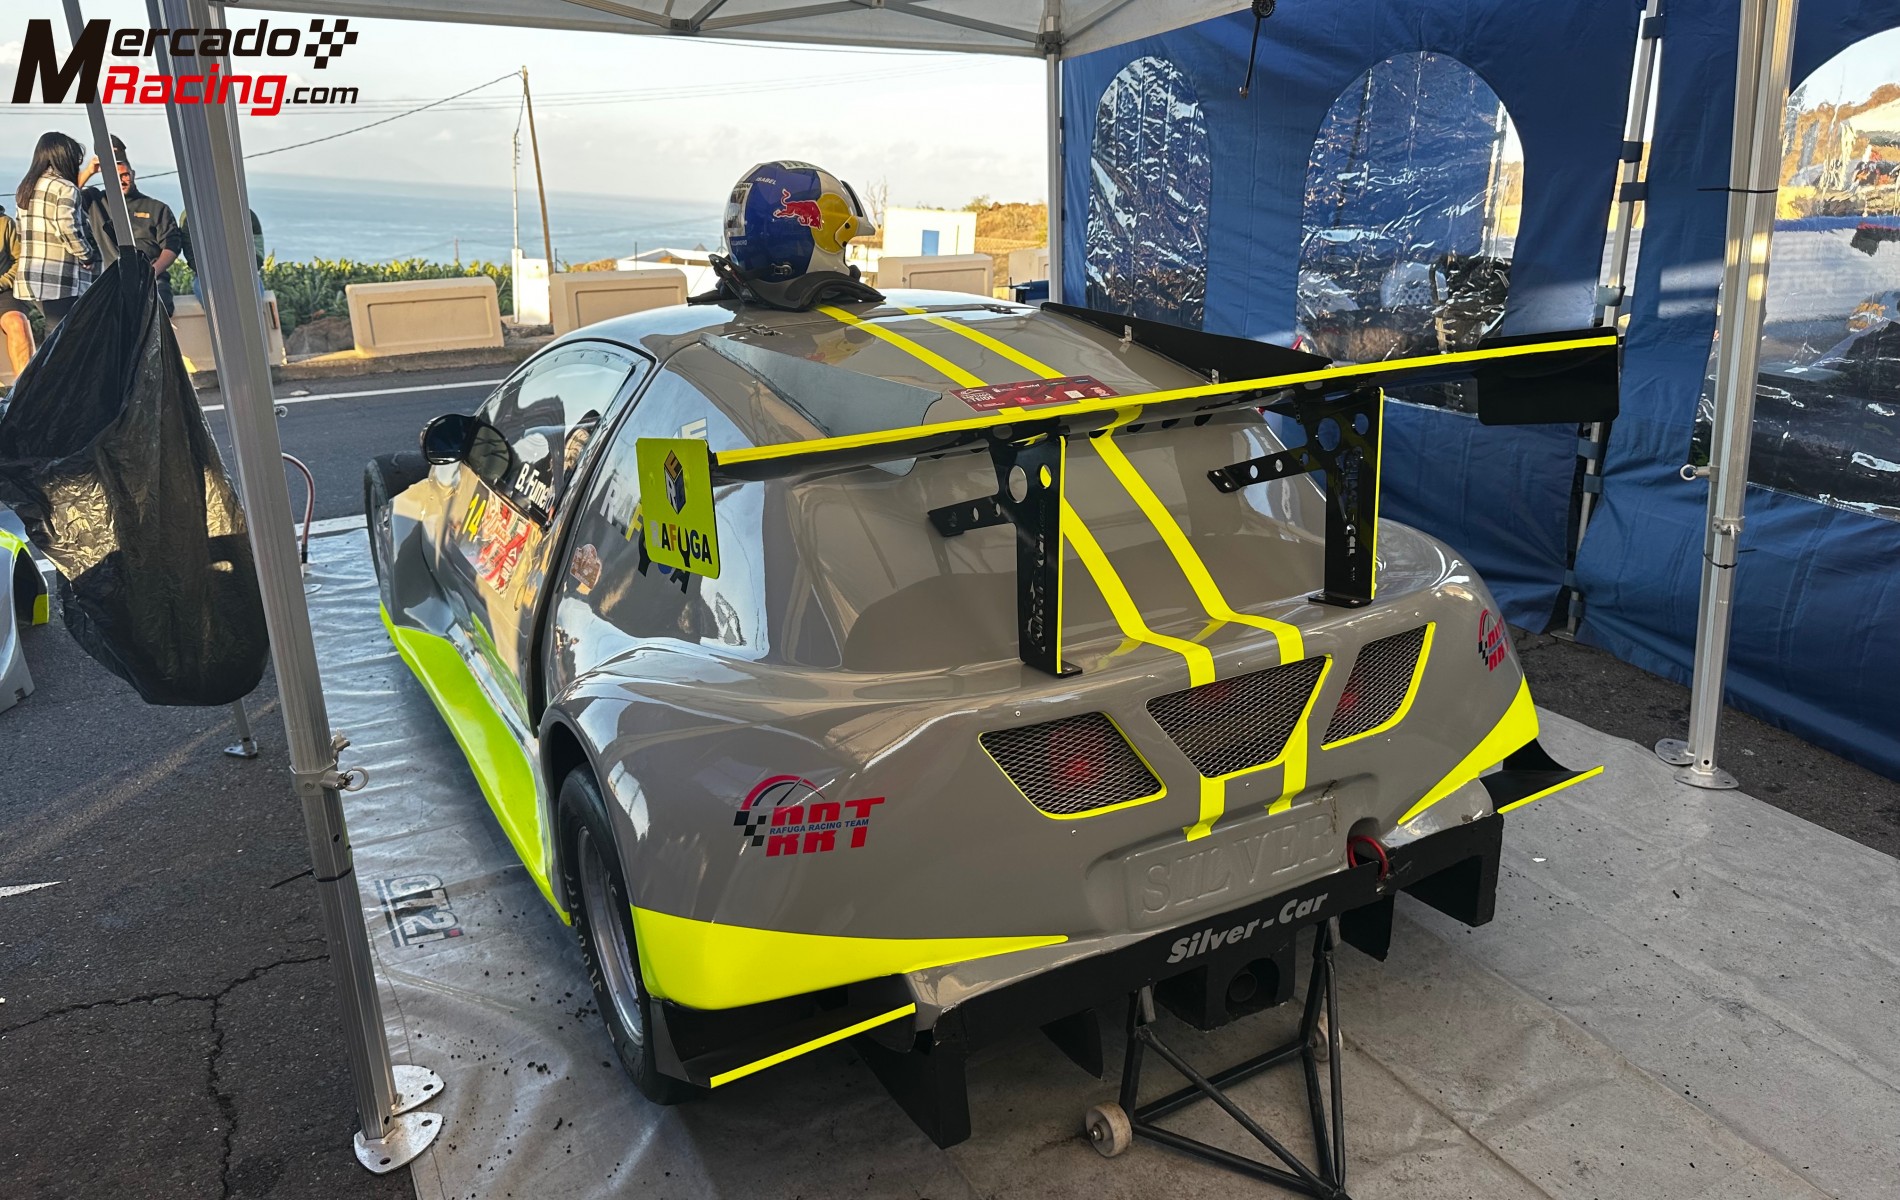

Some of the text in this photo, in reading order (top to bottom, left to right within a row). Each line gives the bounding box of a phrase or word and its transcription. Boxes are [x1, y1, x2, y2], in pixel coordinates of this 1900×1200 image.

[462, 493, 486, 542] 14
[650, 520, 713, 568] RAFUGA
[766, 797, 885, 857] RRT
[769, 818, 870, 835] RAFUGA RACING TEAM
